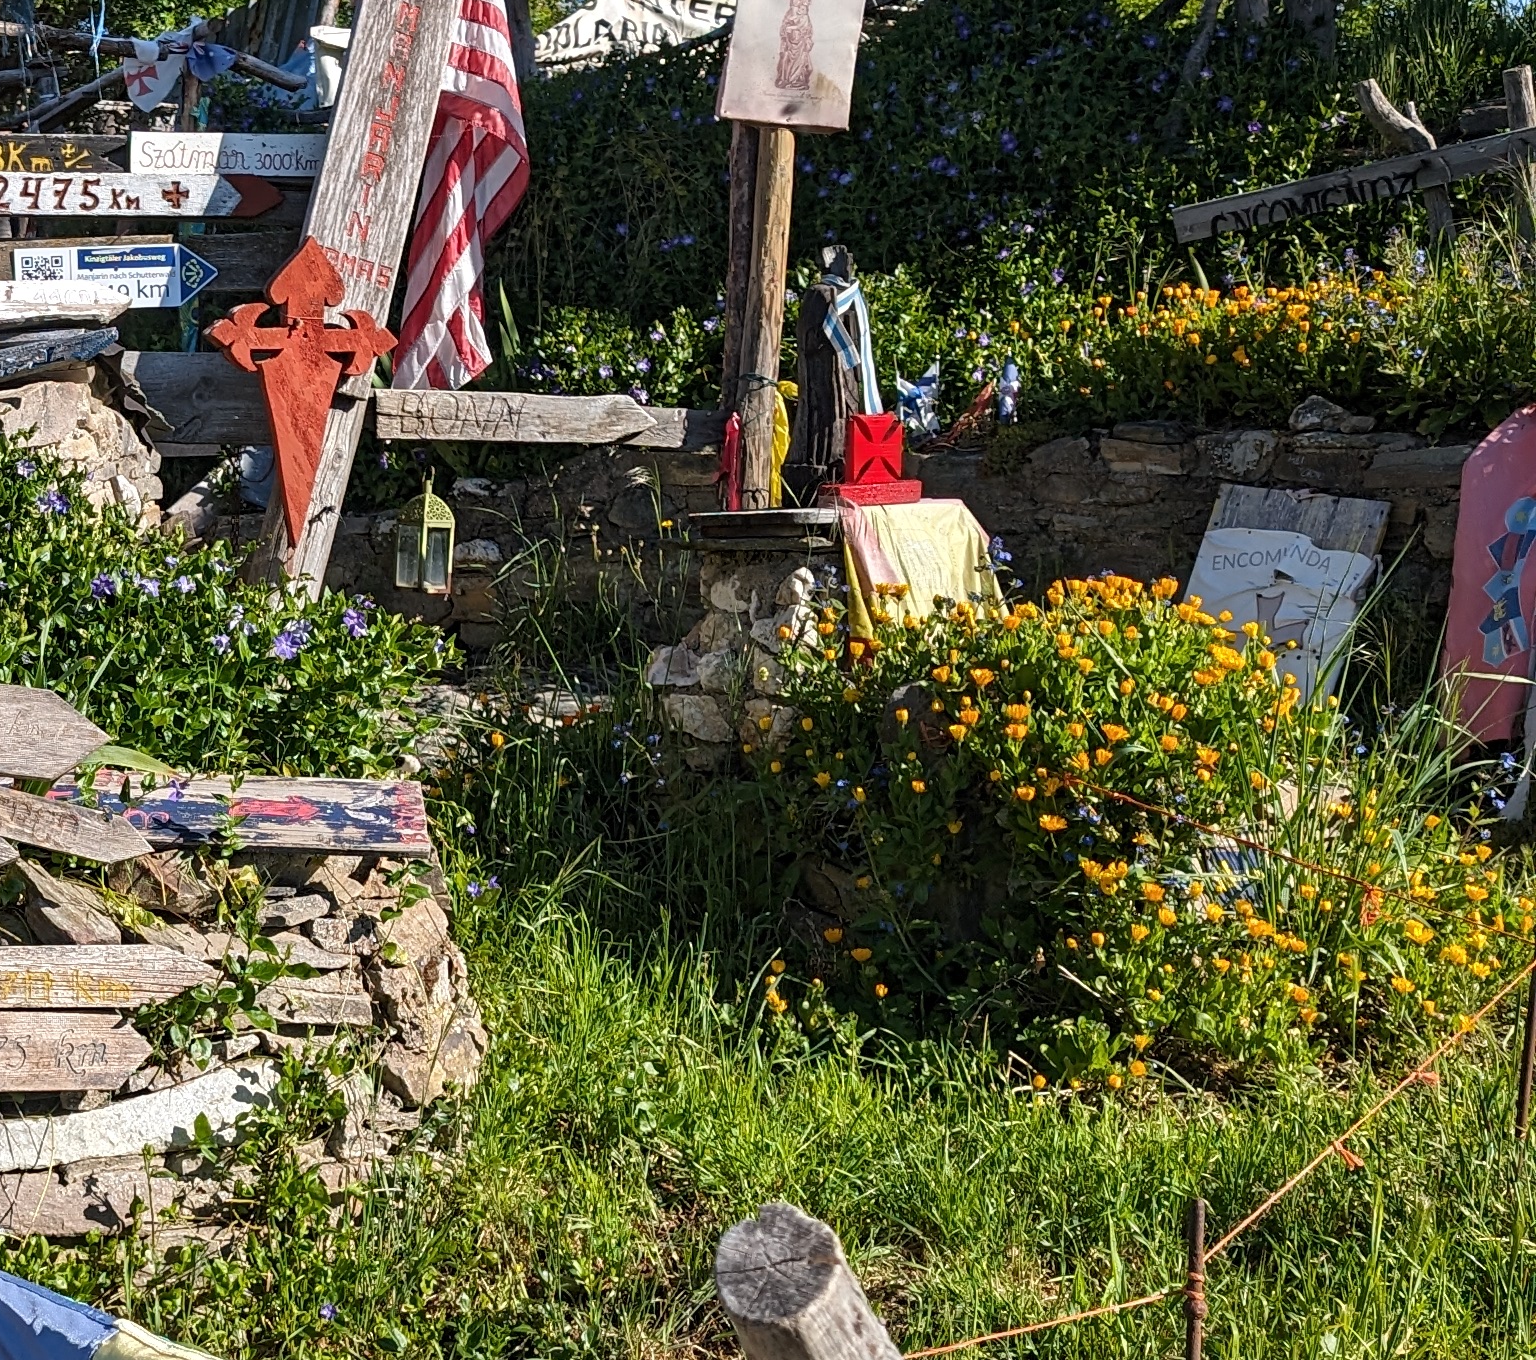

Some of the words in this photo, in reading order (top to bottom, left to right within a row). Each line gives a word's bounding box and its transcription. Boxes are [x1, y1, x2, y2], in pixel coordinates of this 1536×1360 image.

[254, 152, 292, 170] 3000
[109, 271, 127, 280] nach
[128, 270, 177, 280] Schutterwald
[137, 280, 170, 299] km
[52, 1028, 110, 1077] km
